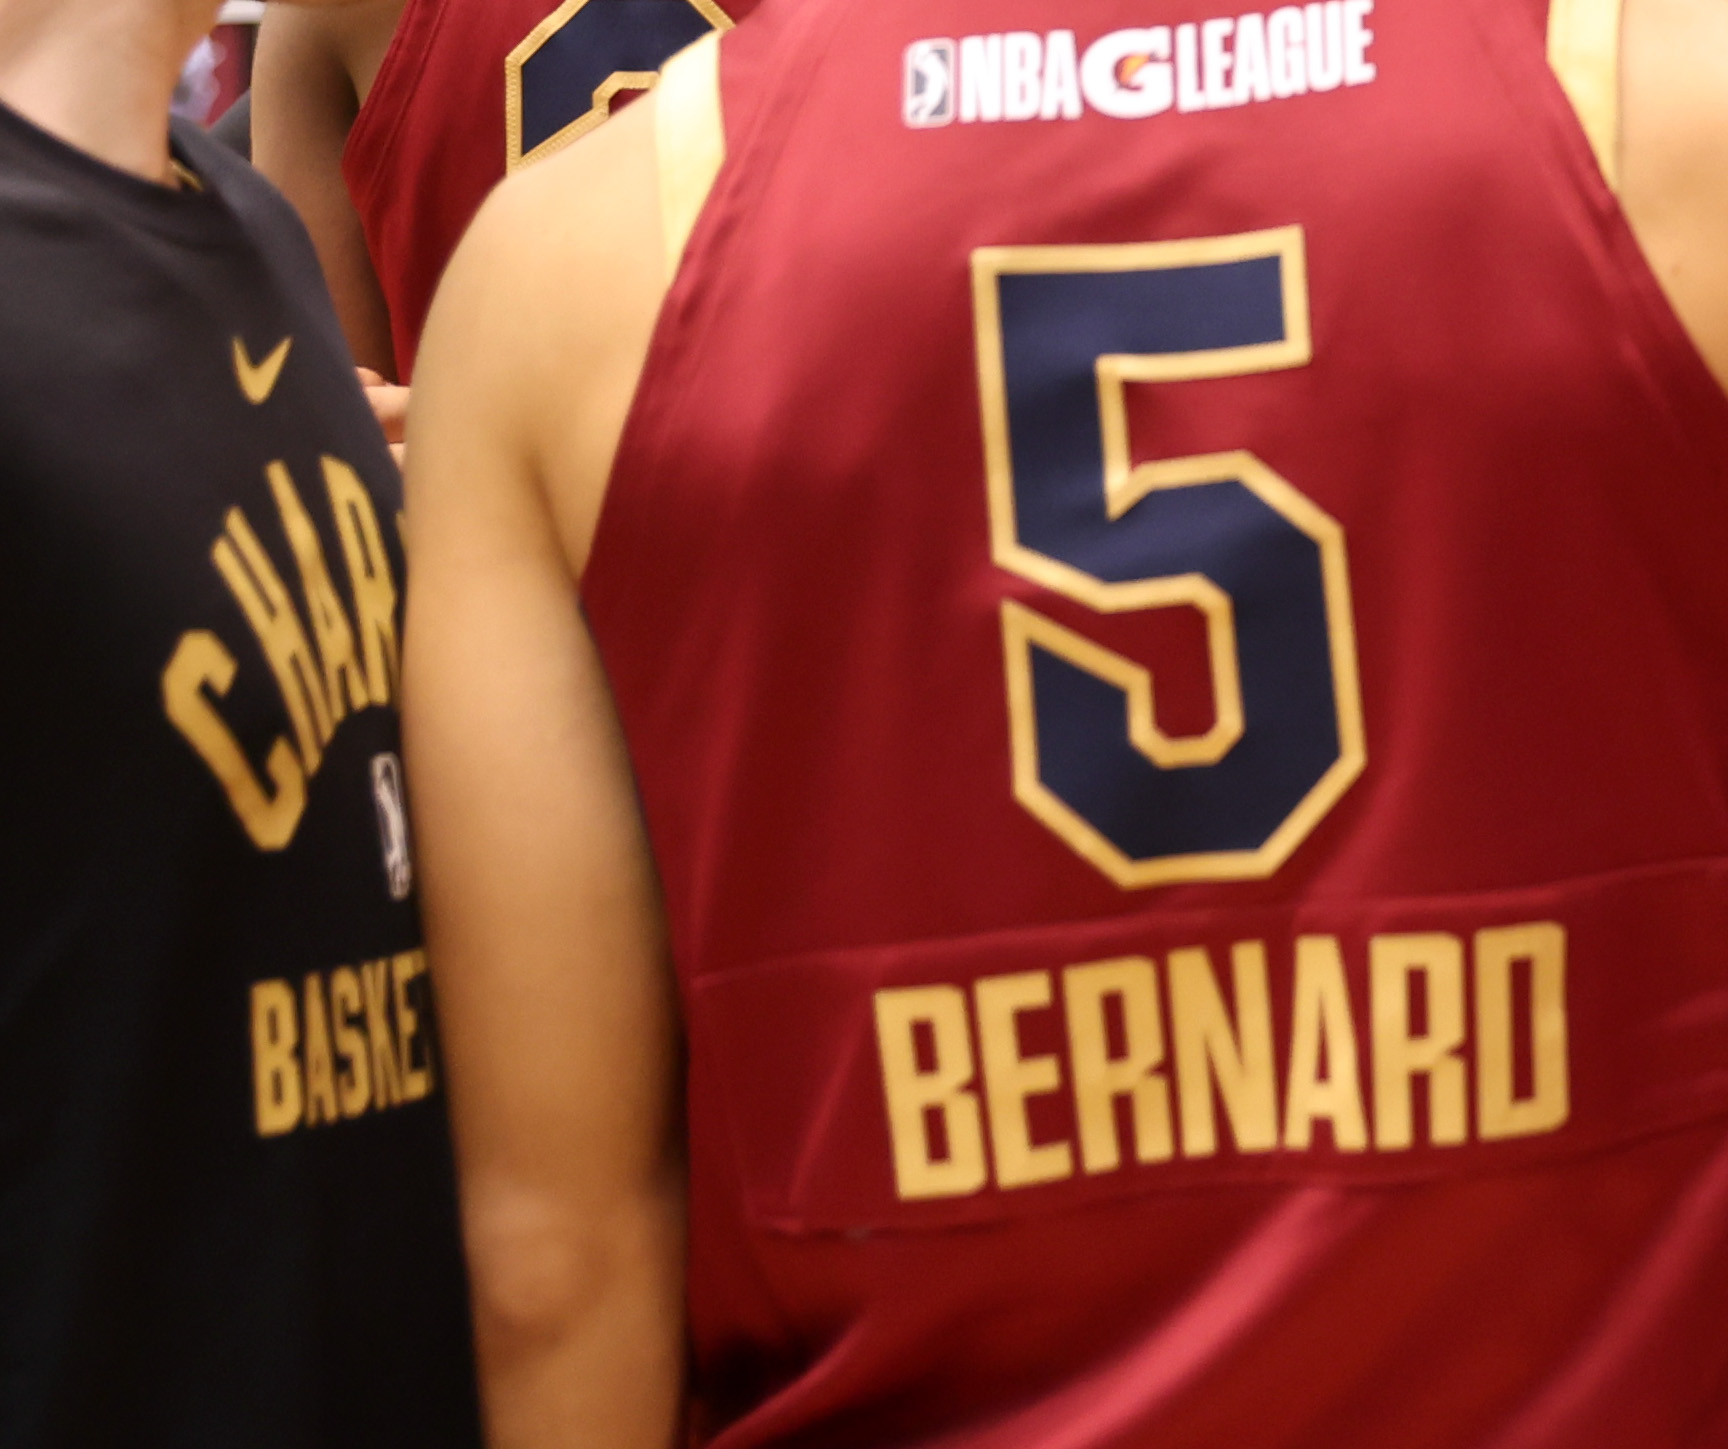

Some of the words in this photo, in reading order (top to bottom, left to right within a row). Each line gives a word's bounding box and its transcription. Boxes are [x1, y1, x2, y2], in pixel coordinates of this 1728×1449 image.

[161, 453, 405, 852] CHAR
[971, 223, 1368, 892] 5
[874, 920, 1571, 1203] BERNARD
